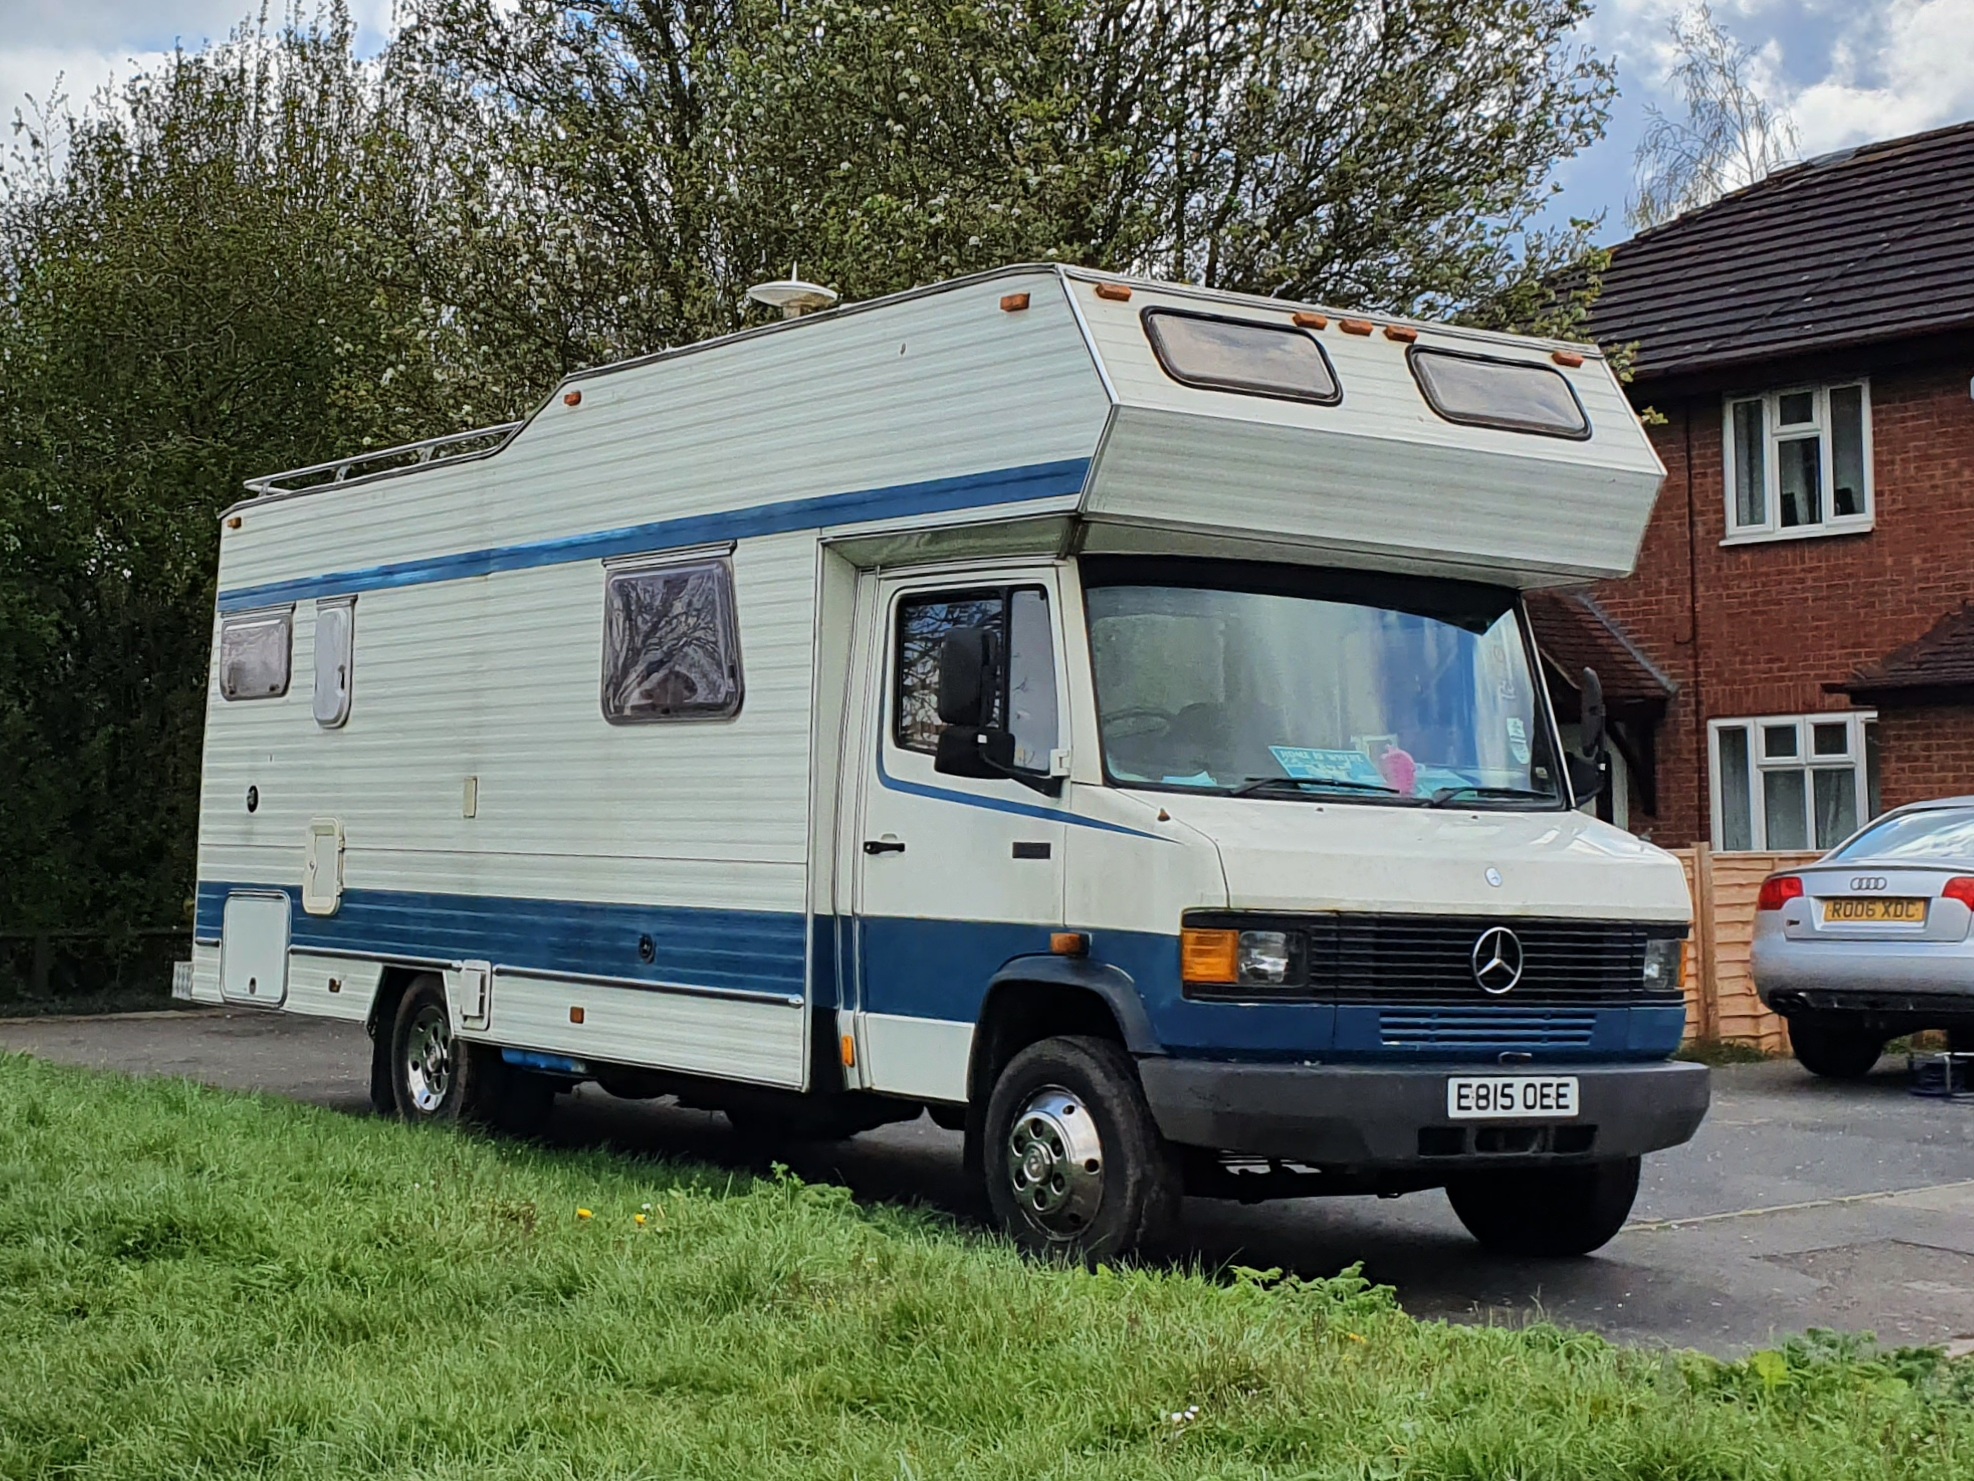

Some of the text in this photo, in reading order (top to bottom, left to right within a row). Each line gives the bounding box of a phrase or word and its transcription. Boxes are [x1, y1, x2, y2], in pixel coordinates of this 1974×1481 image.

[1881, 900, 1917, 918] XDC
[1457, 1082, 1570, 1111] E815 OEE
